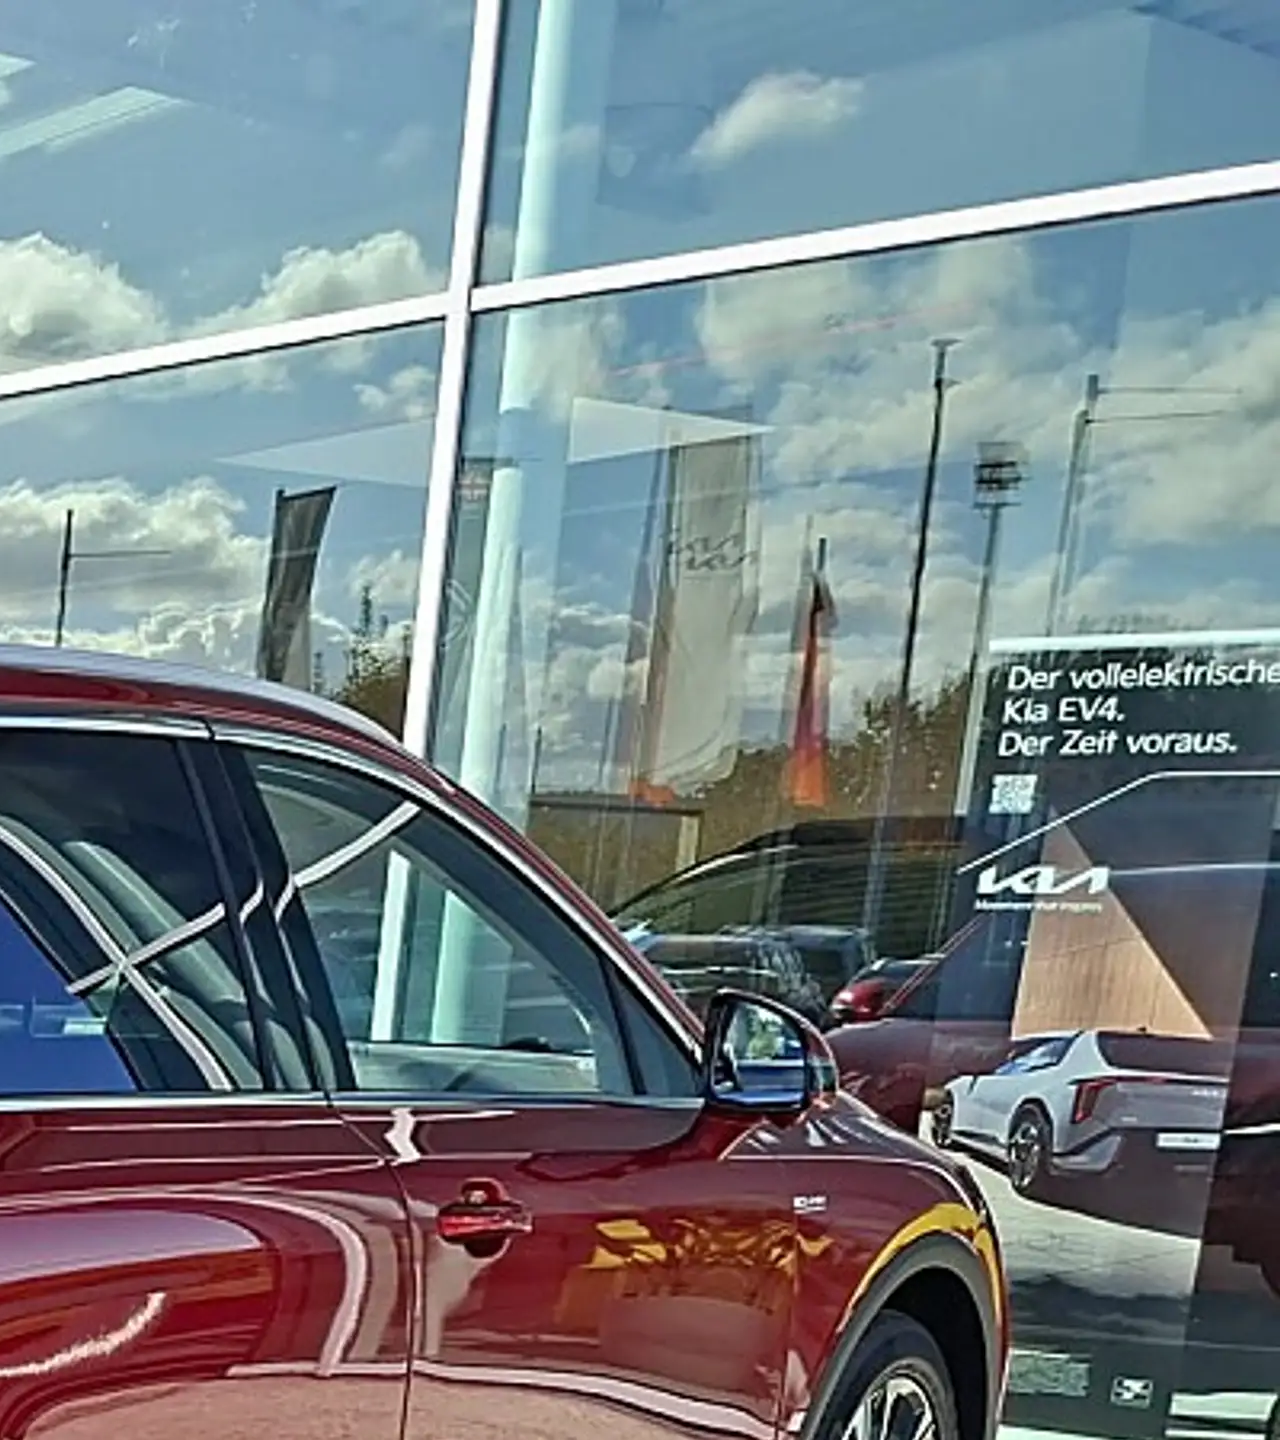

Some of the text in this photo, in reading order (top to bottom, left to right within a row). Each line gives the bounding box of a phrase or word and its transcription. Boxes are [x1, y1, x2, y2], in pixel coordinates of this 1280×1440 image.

[1007, 665, 1062, 690] Der
[1002, 695, 1126, 724] Kia EV4.
[998, 730, 1238, 756] Der Zeit voraus.
[977, 865, 1110, 894] KIA
